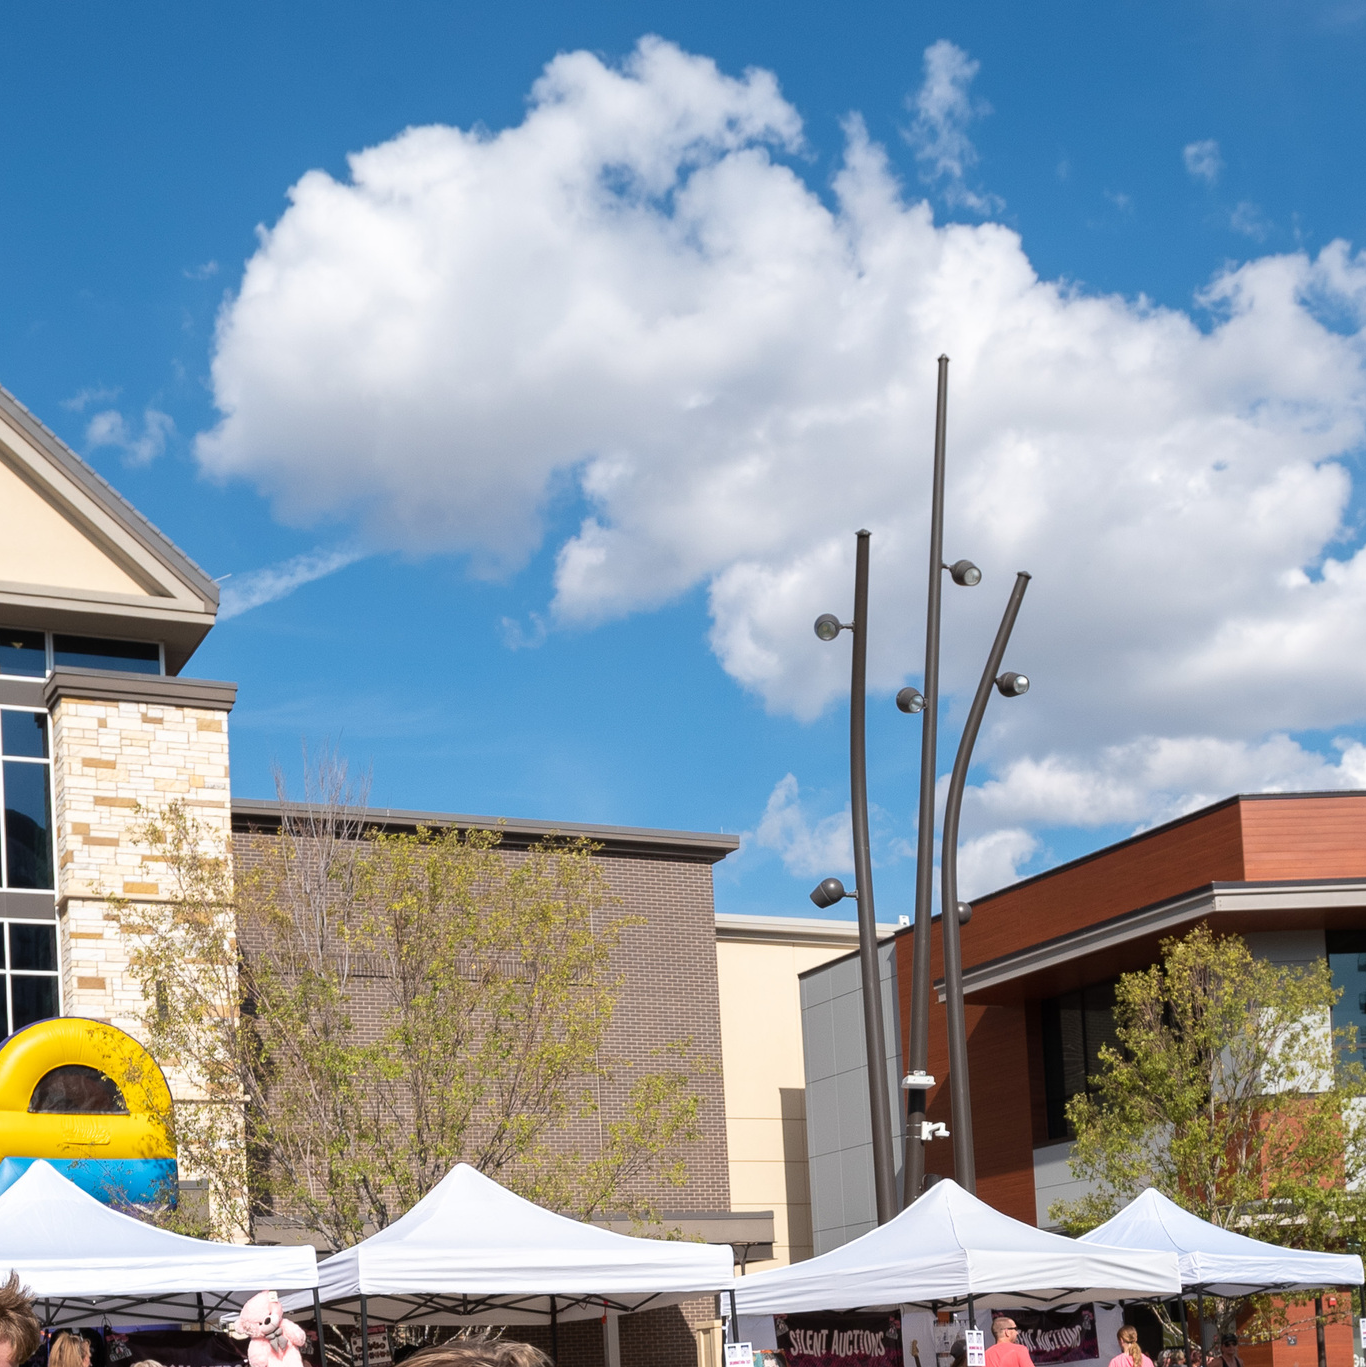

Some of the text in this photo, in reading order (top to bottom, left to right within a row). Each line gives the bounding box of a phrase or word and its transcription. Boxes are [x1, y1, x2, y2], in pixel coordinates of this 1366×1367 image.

[789, 1329, 886, 1357] SILENT AUCTIONS
[1035, 1325, 1082, 1352] AUCTIONS
